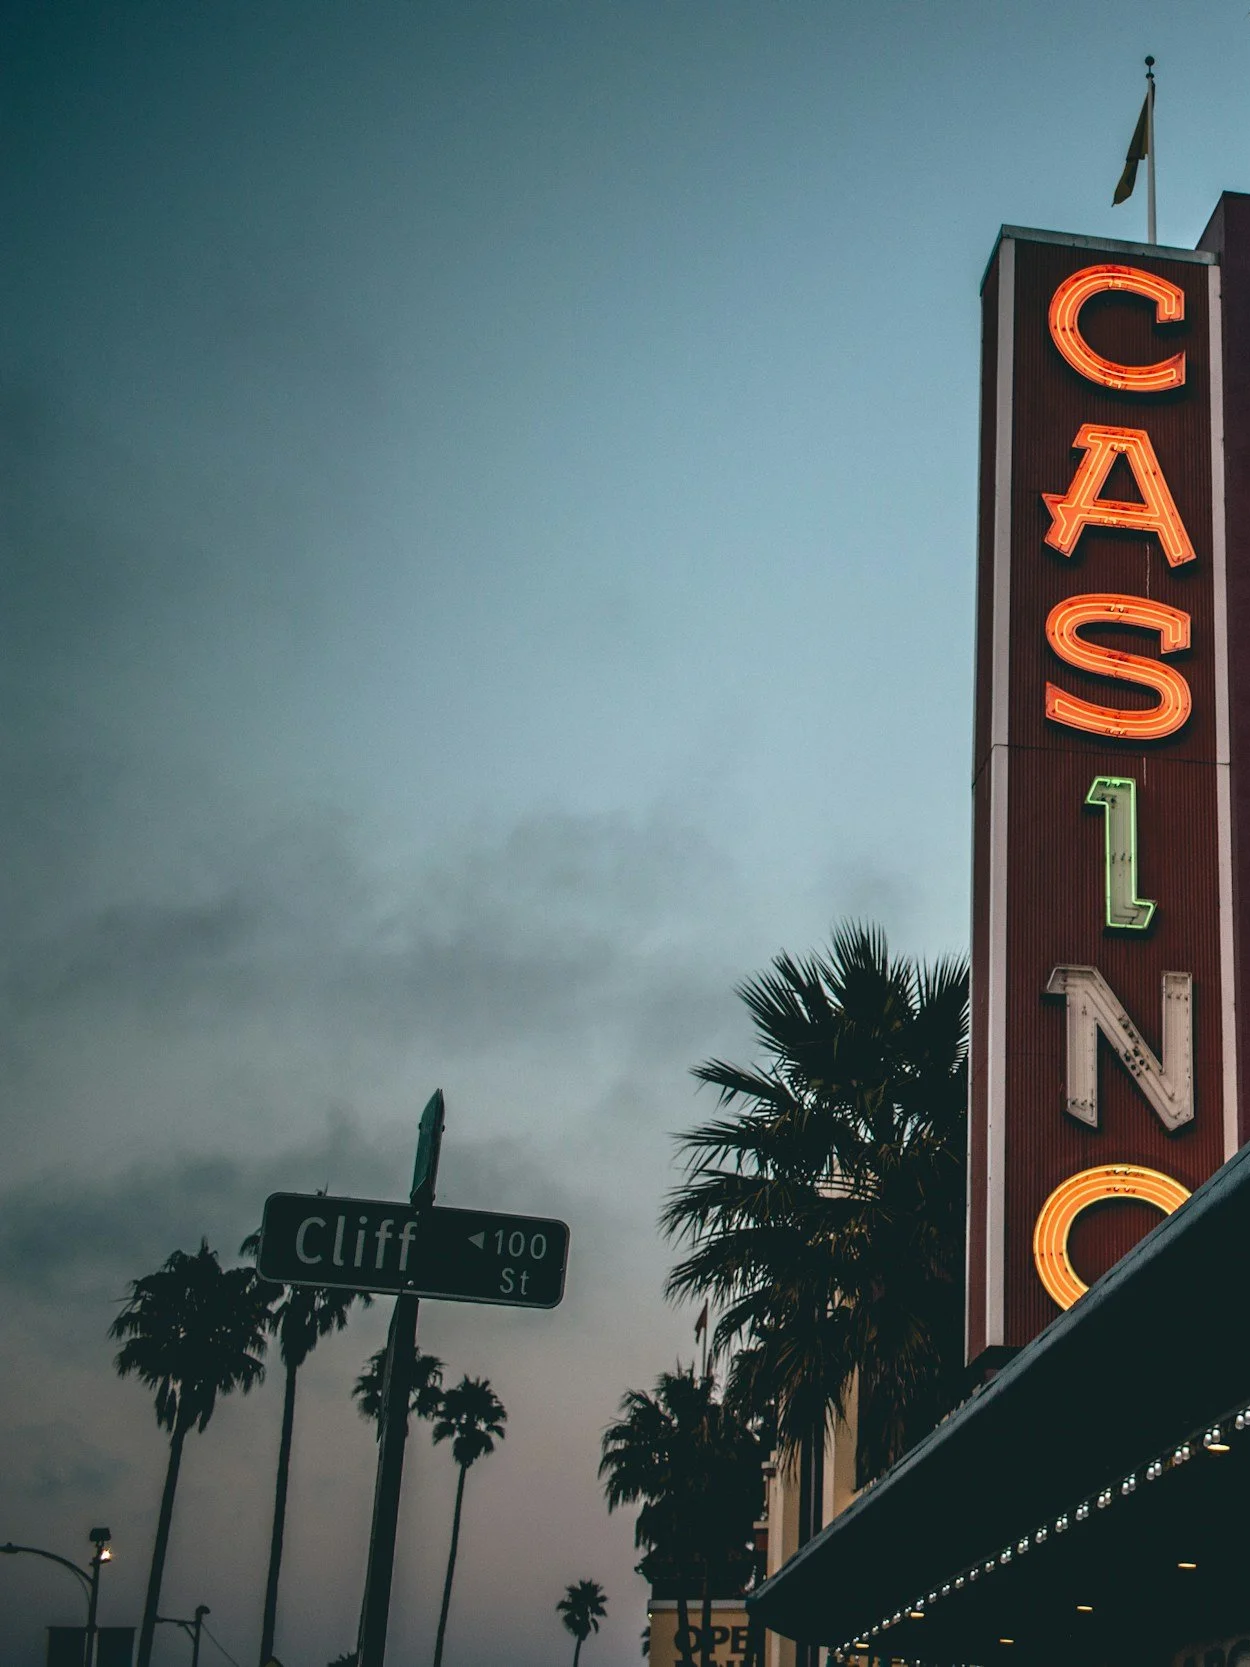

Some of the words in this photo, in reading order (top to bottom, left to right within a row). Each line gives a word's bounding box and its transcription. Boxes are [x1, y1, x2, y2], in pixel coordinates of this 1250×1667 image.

[295, 1215, 418, 1272] Cliff
[494, 1229, 547, 1260] 100
[499, 1267, 530, 1296] St
